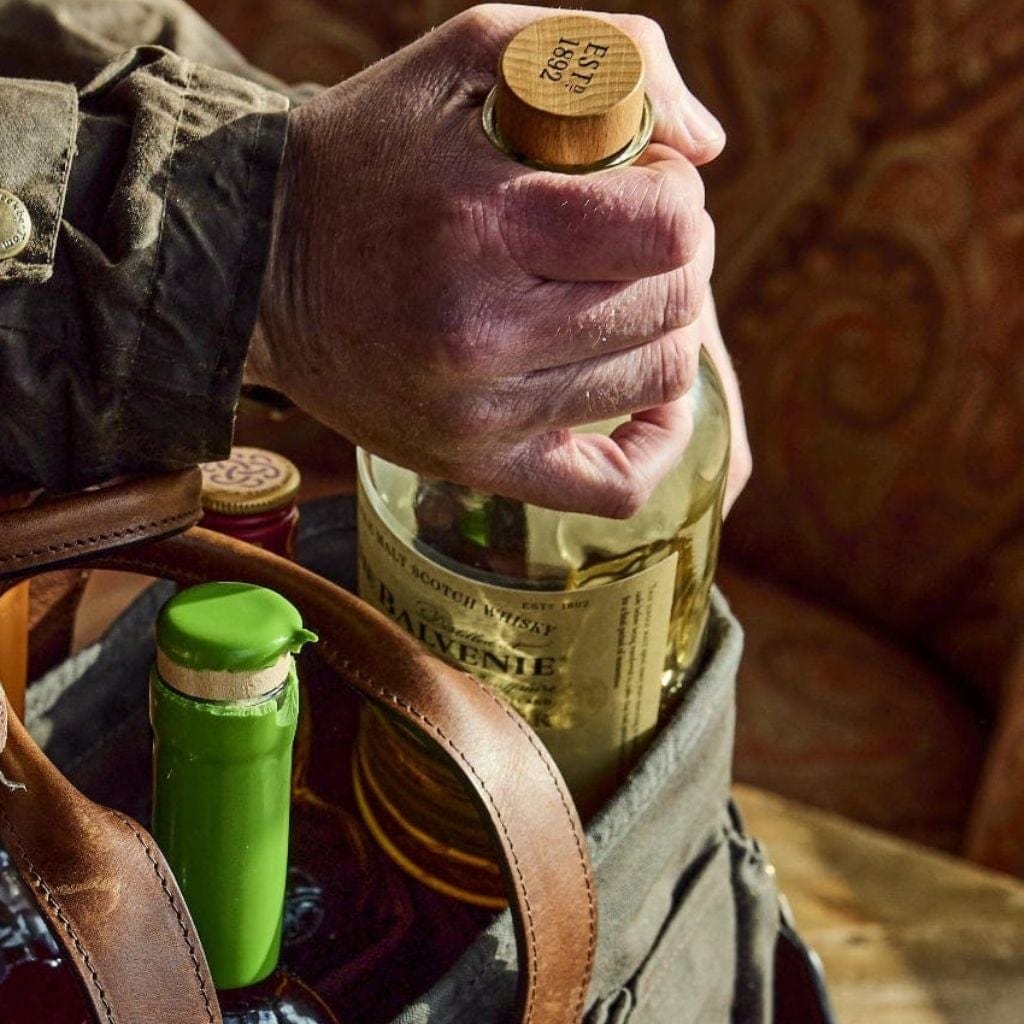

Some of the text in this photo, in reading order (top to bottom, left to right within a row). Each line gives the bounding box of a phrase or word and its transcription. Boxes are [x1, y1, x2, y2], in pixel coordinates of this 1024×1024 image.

[539, 37, 579, 82] 1892
[379, 583, 556, 677] BALVENIE
[412, 566, 476, 610] SCOTCH
[484, 604, 556, 637] WHISKY
